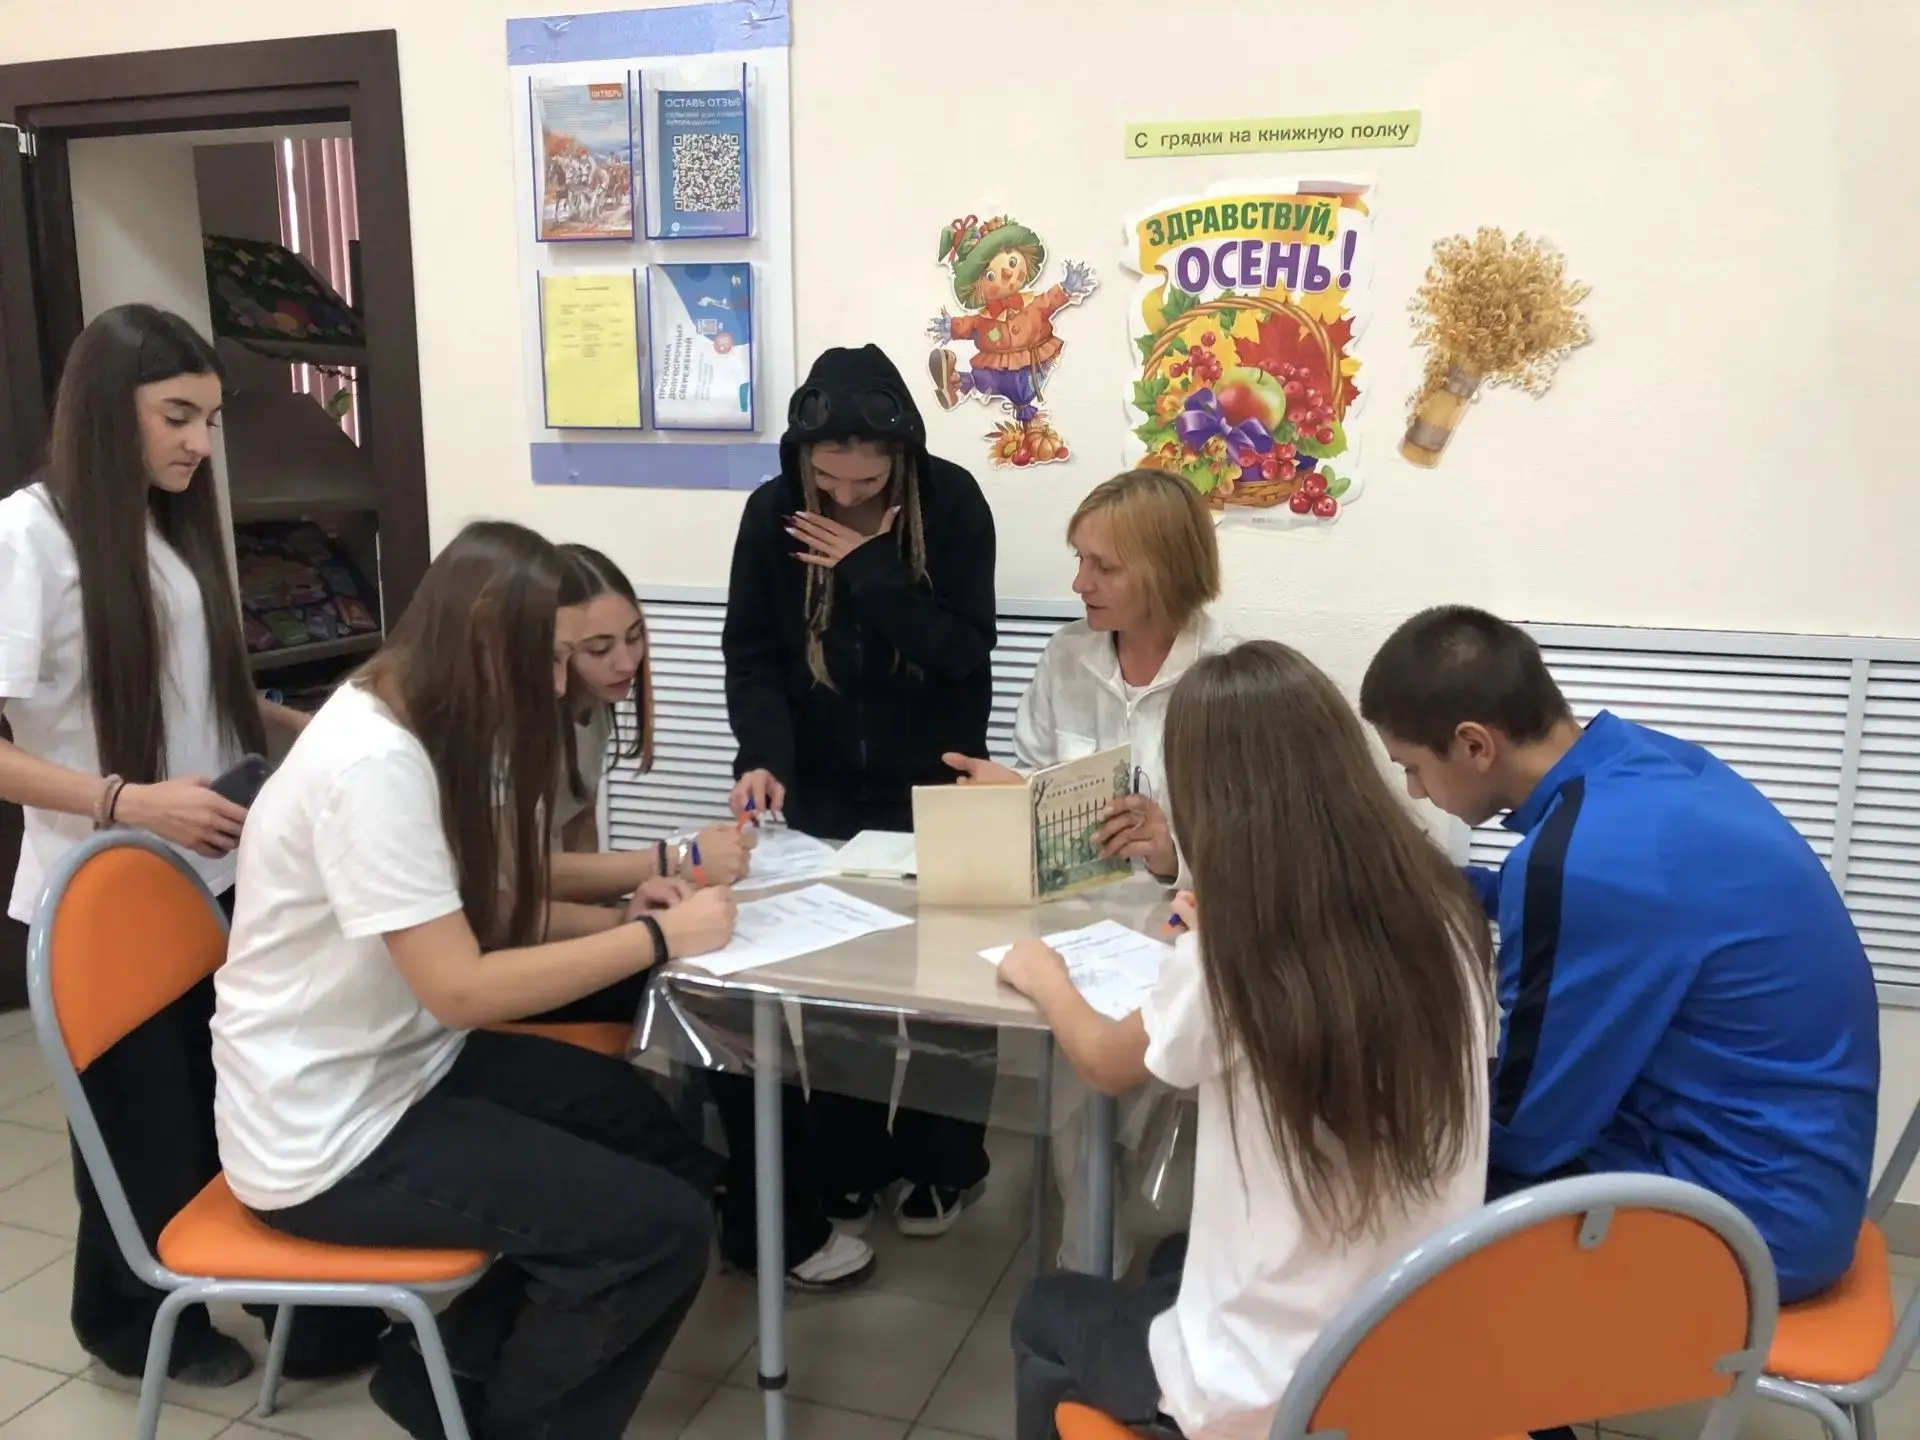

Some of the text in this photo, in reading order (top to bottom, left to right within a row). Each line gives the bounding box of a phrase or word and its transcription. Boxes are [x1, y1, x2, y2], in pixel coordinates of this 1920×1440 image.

[664, 98, 705, 108] ОСТАВЬ
[1134, 123, 1410, 150] С грядки на книжную полку
[1146, 201, 1335, 247] ЗДРАВСТВУЙ,
[1176, 229, 1358, 294] ОСЕНЬ!
[658, 343, 672, 400] ПРОГРАММА
[668, 323, 683, 400] ДОЛГОСРОЧНЫХ
[678, 337, 692, 400] СБЕРЕЖЕНИЙ
